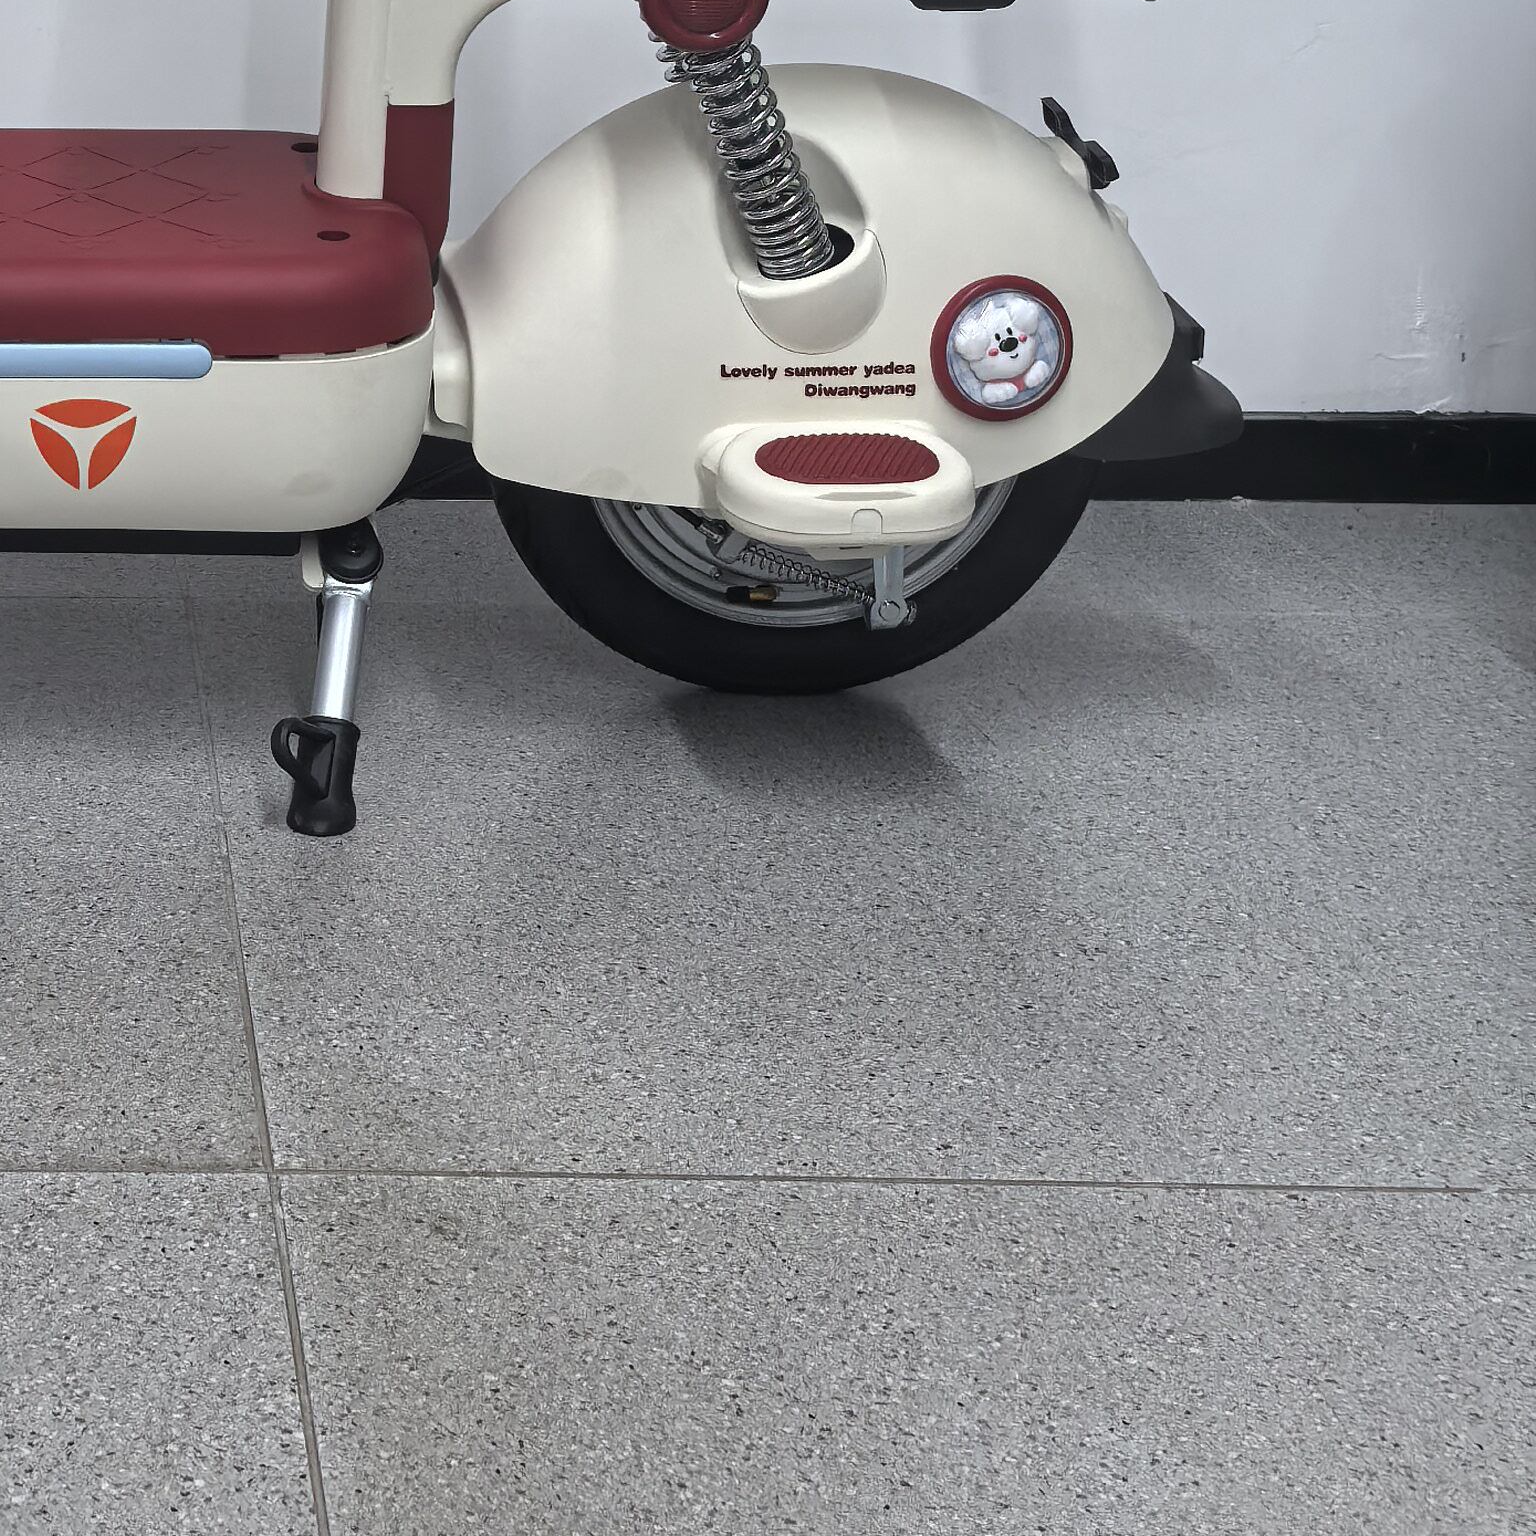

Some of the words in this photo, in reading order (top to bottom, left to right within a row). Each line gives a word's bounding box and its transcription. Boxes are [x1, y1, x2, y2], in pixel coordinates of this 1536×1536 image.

[720, 363, 778, 380] Lovely
[784, 364, 858, 378] summer
[864, 361, 916, 378] yadea
[804, 383, 917, 399] Diwangwang
